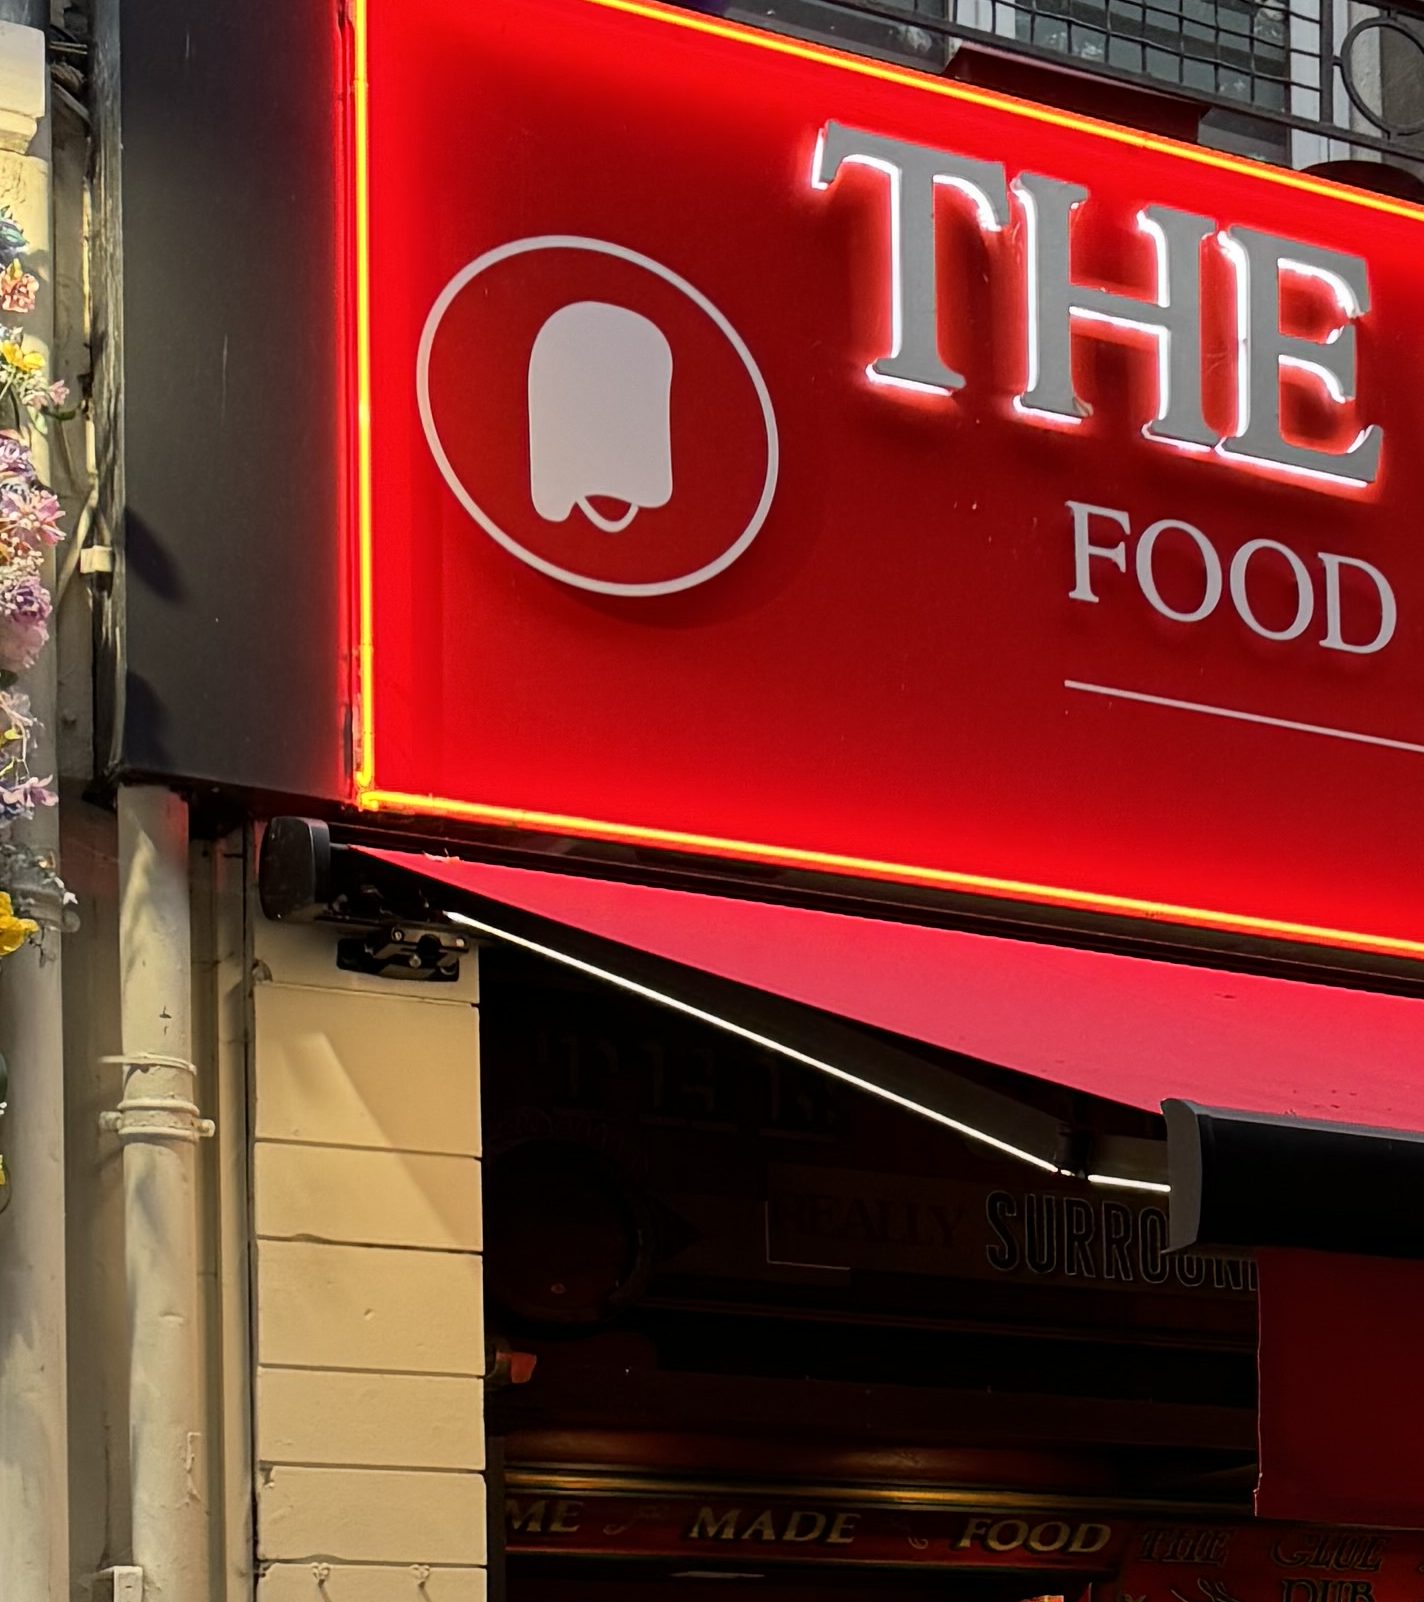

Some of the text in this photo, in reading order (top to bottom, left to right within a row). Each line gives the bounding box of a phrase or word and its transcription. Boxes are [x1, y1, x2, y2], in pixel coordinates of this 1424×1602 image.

[808, 118, 1383, 488] THE
[1066, 500, 1398, 655] FOOD
[985, 1190, 1258, 1291] SURRO
[690, 1505, 862, 1545] MADE
[955, 1518, 1113, 1552] FOOD
[1139, 1527, 1236, 1568] THE
[1272, 1532, 1392, 1571] GLUE
